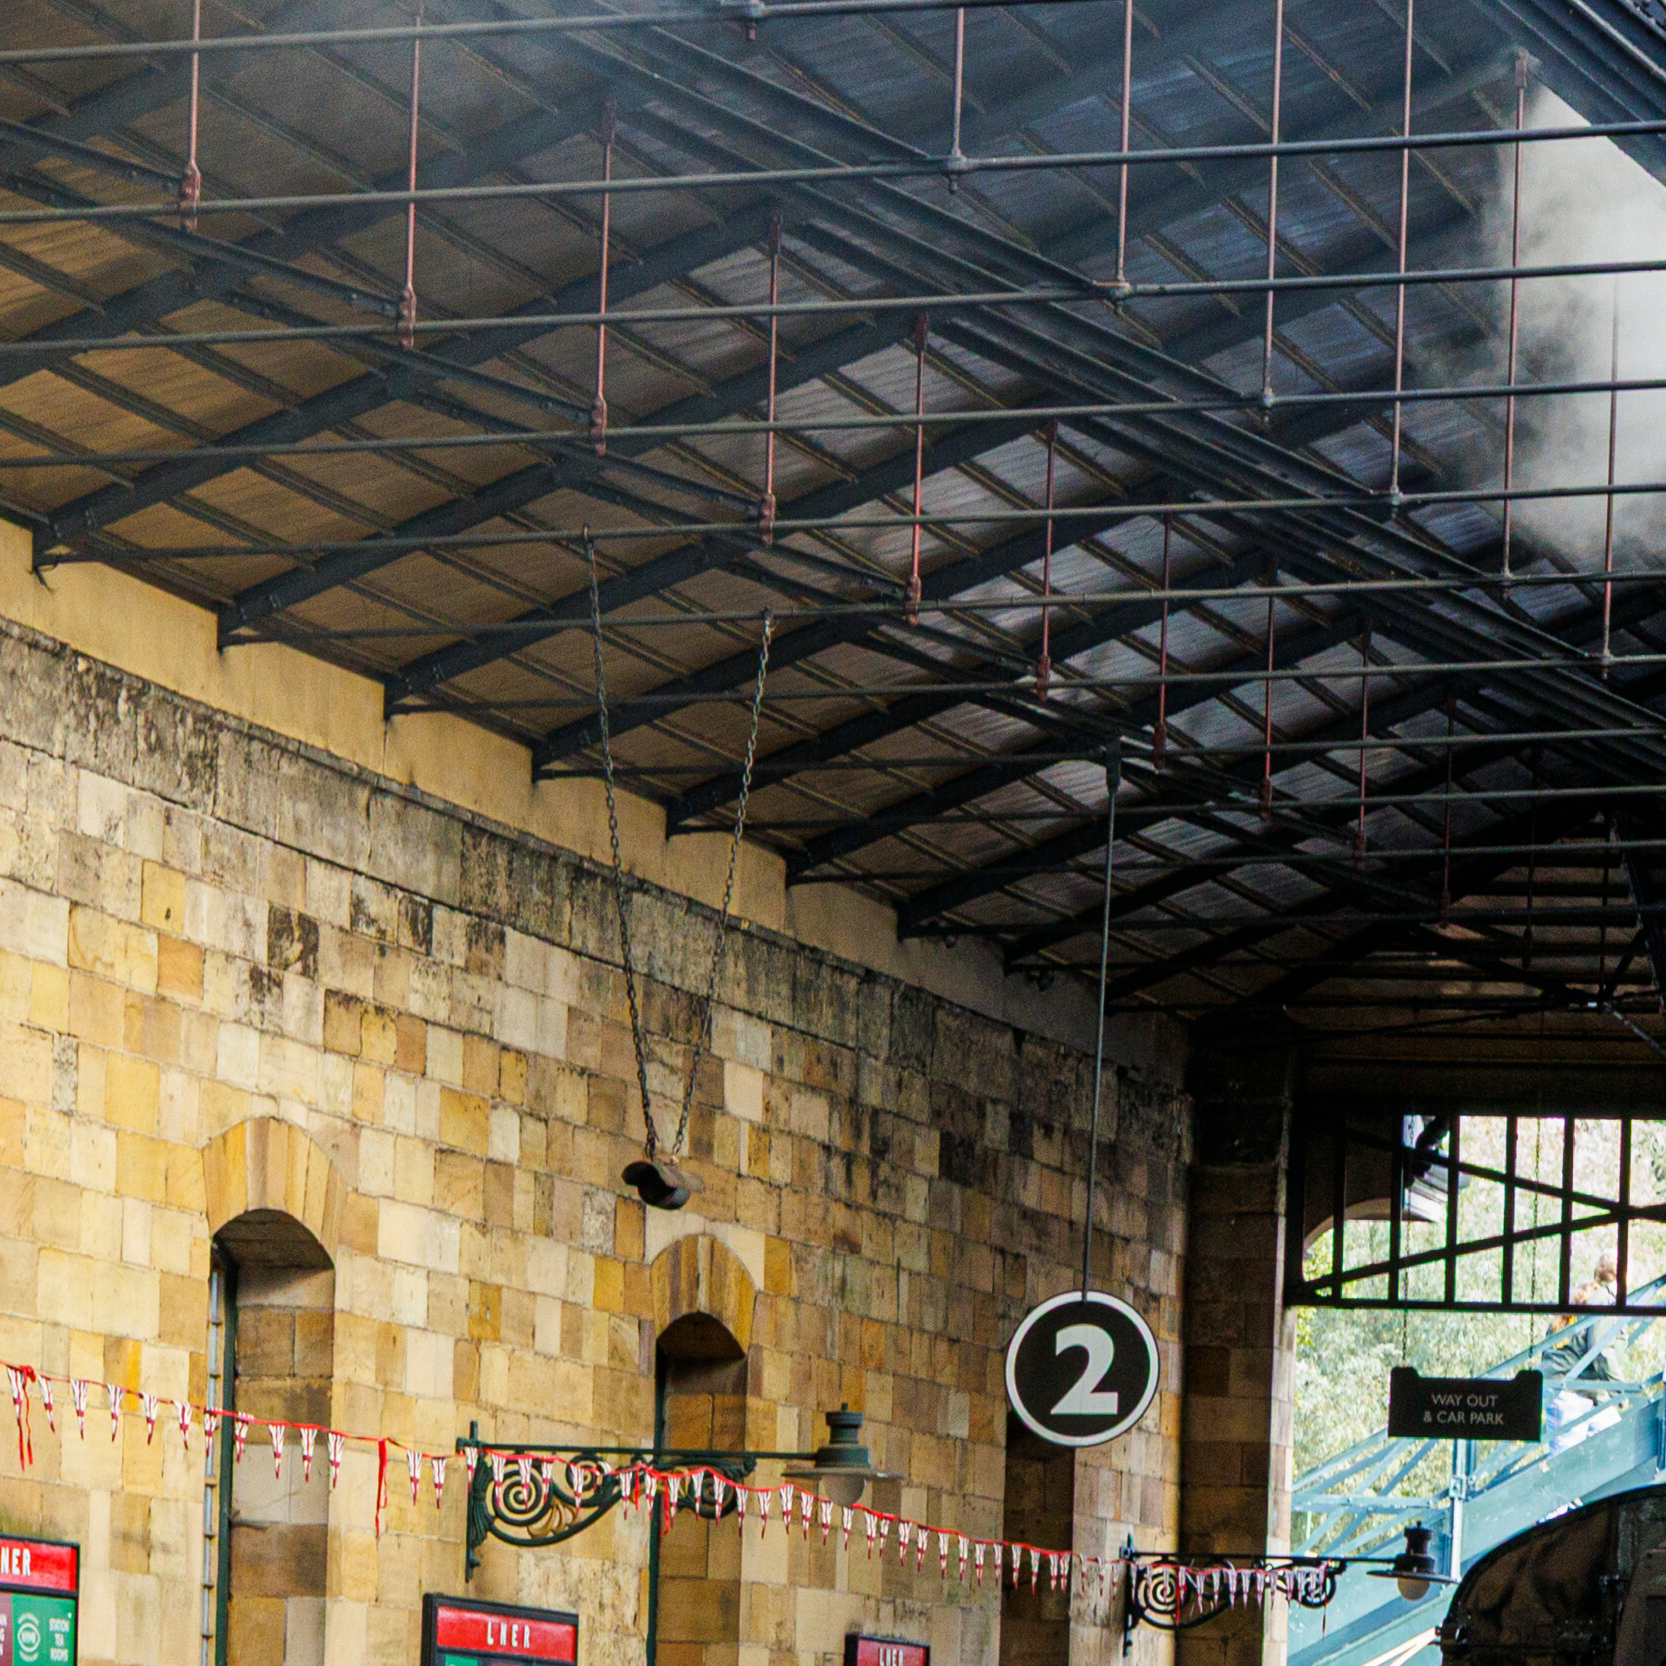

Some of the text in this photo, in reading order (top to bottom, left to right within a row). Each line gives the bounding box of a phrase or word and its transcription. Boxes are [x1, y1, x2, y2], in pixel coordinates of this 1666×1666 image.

[1049, 1323, 1119, 1416] 2
[1431, 1393, 1499, 1408] WAY OUT
[1423, 1410, 1505, 1426] & CAR PARK
[486, 1621, 531, 1649] LNER
